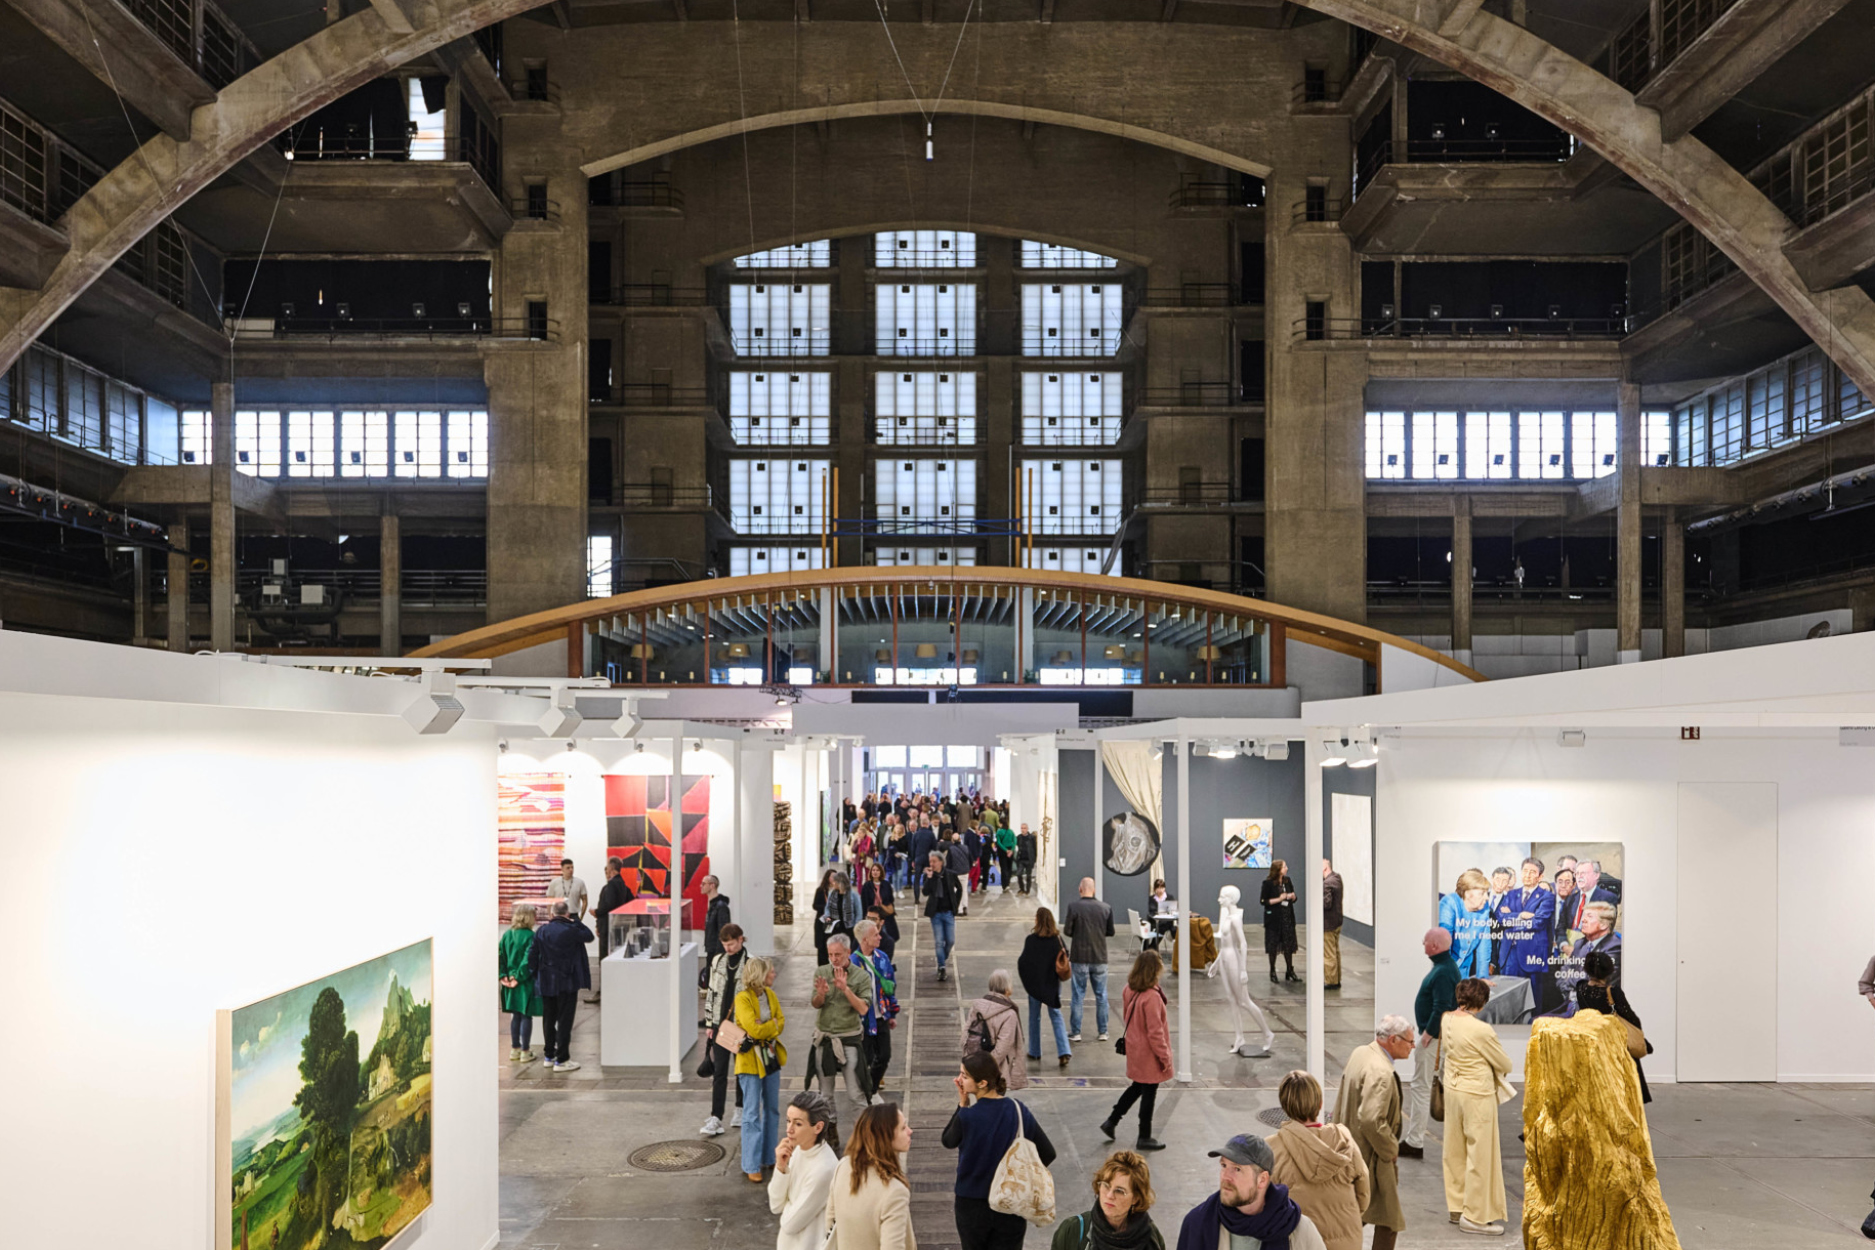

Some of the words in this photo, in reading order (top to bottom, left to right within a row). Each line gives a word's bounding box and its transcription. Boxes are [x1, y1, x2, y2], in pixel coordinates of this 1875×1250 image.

[1455, 917, 1471, 929] My
[1473, 917, 1499, 929] body,
[1502, 917, 1533, 929] telling
[1454, 931, 1471, 940] me
[1479, 930, 1503, 940] need
[1505, 930, 1535, 941] water
[1526, 954, 1545, 967] Me,
[1547, 954, 1585, 967] drinking
[1554, 968, 1587, 979] coffee
